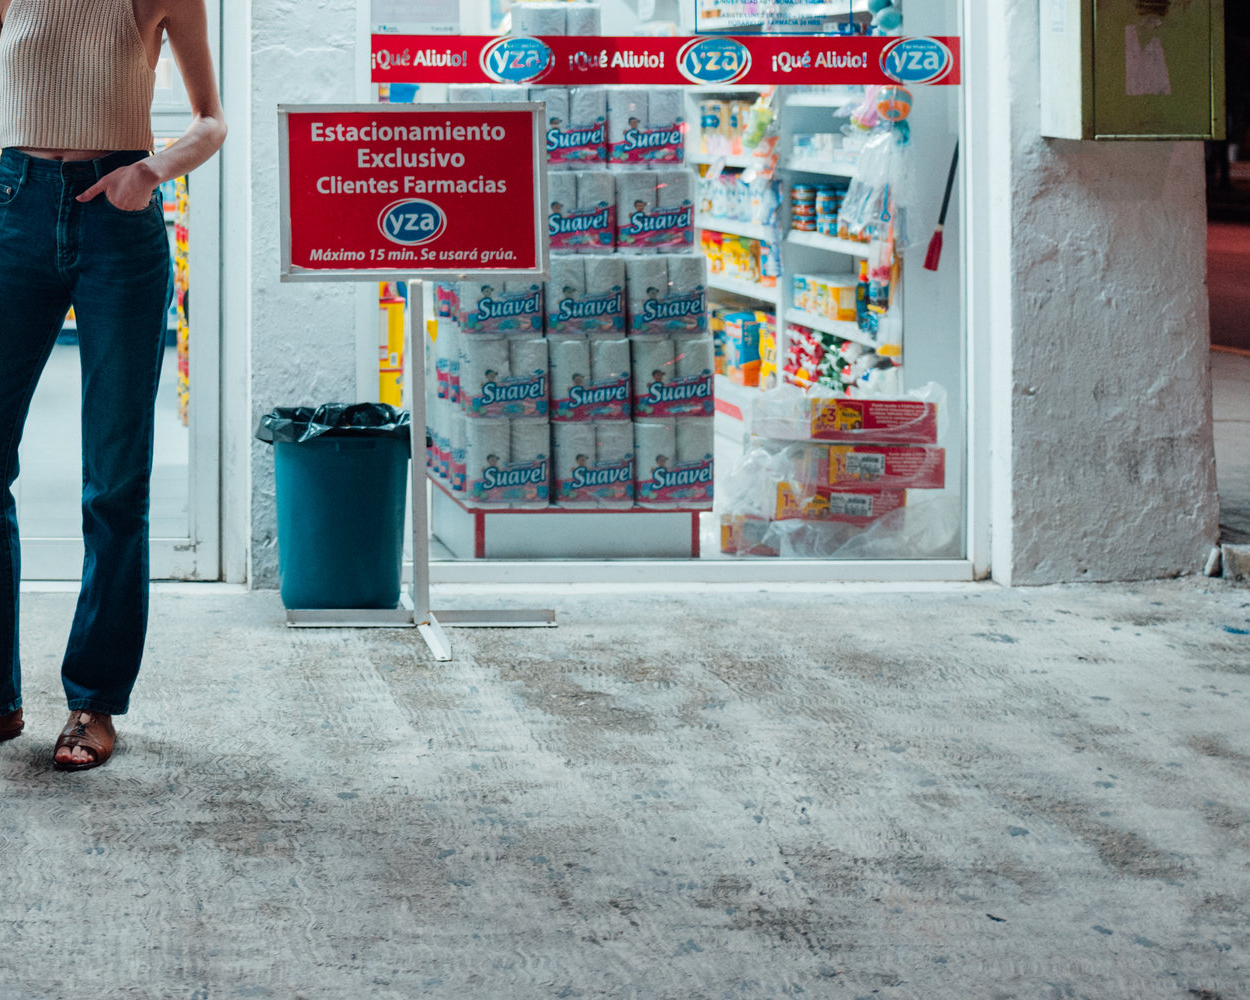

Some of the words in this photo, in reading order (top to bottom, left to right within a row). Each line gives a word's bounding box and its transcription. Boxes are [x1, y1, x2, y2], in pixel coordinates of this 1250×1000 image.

[371, 49, 410, 70] ¡Qué
[414, 49, 467, 67] Alivio!
[495, 50, 541, 74] yza
[569, 51, 608, 71] ¡Qué
[611, 51, 665, 68] Alivio!
[689, 51, 738, 74] yza
[772, 52, 811, 72] ¡Qué
[815, 52, 868, 68] Alivio!
[891, 51, 939, 73] yza
[311, 121, 506, 142] Estacionamiento
[547, 126, 605, 150] Suavel
[624, 128, 683, 151] Suavel
[357, 147, 465, 168] Exclusivo
[316, 176, 399, 194] Clientes
[403, 175, 506, 194] Farmacias
[389, 213, 435, 235] yza
[549, 211, 609, 235] Suavel
[630, 211, 692, 234] Suavel
[309, 248, 365, 261] Máximo
[369, 249, 386, 261] 15
[388, 249, 418, 261] min.
[420, 249, 436, 261] Se
[439, 248, 478, 261] usará
[480, 248, 517, 264] grúa.
[477, 294, 541, 320] Suavel
[559, 294, 623, 320] Suavel
[644, 293, 707, 321] Suavel
[481, 376, 546, 405] Suavel
[569, 380, 630, 408] Suavel
[649, 376, 712, 404] Suavel
[483, 462, 547, 490] Suavel
[572, 461, 634, 489] Suavel
[652, 461, 713, 490] Suavel
